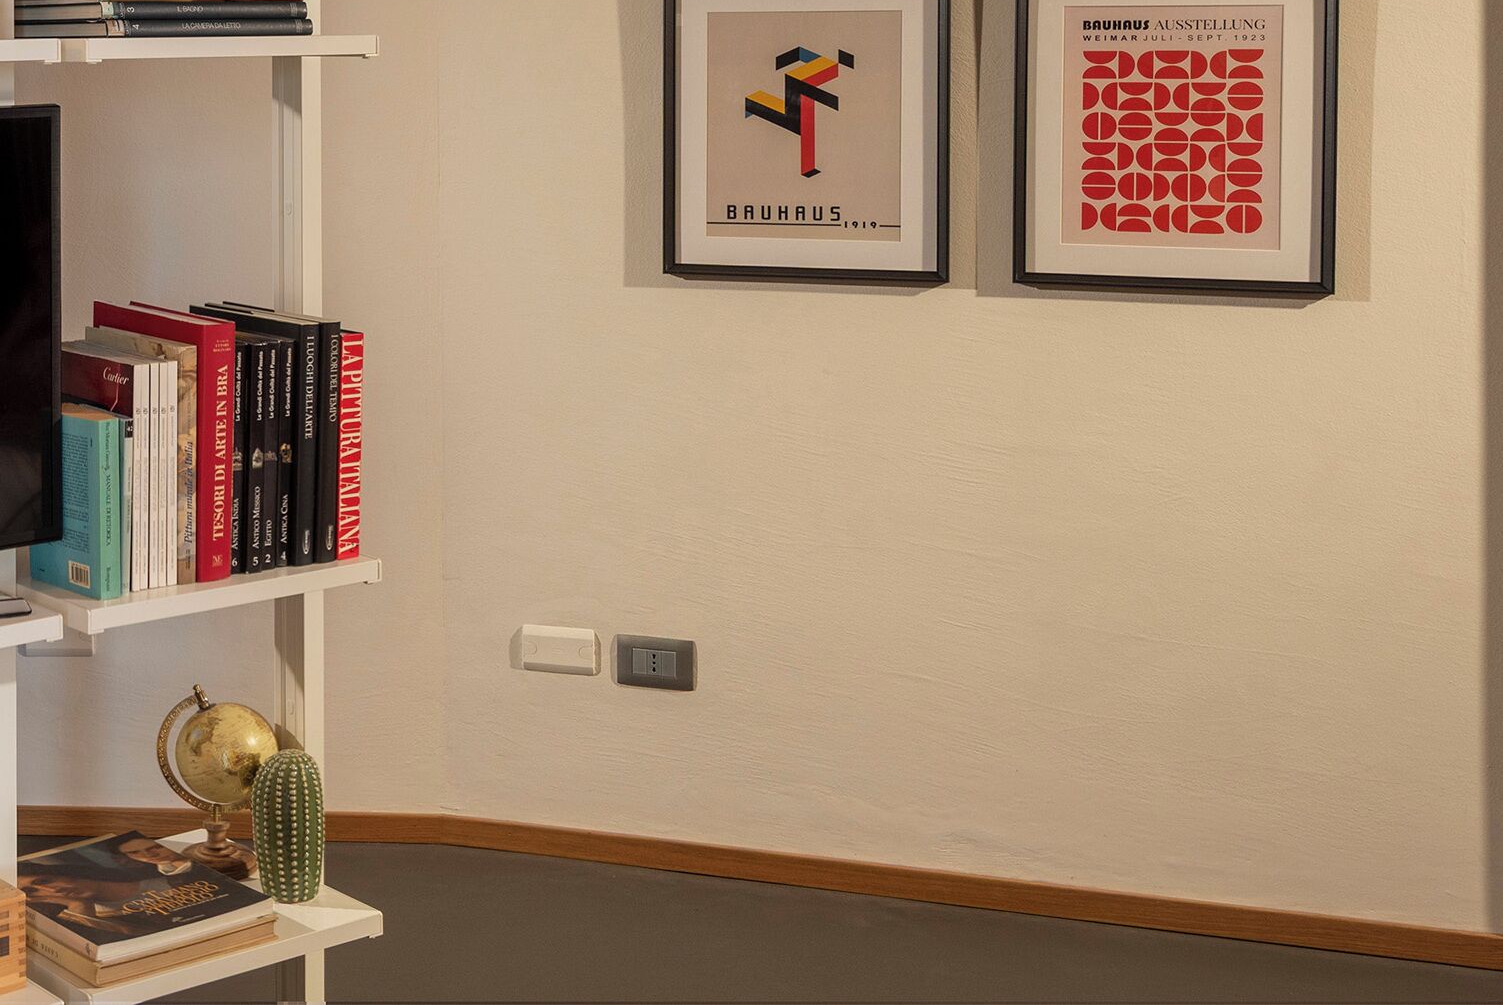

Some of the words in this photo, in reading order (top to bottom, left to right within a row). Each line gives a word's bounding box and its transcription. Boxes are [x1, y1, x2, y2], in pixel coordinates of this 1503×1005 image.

[1082, 19, 1150, 31] BAUHAUS
[1154, 18, 1266, 31] AUSSTELLUNG
[726, 205, 841, 222] BAUHAUS
[844, 221, 878, 229] 1919
[306, 342, 314, 383] LUOGHI
[330, 339, 338, 372] COLORI
[341, 340, 363, 364] LA
[102, 366, 130, 386] Cartier
[216, 365, 228, 396] BRA
[330, 374, 338, 390] DEL
[216, 400, 227, 416] IN
[304, 385, 314, 439] DELL'ARTE
[329, 392, 337, 422] TEMPO
[339, 368, 363, 459] PITTURA
[215, 420, 227, 459] ARTE
[184, 442, 193, 468] Italia
[214, 463, 225, 481] DI
[184, 479, 193, 510] murale
[280, 494, 288, 514] CINA
[338, 460, 362, 554] ITALIANA
[213, 485, 225, 541] TESORI
[184, 511, 193, 544] Pittura
[280, 515, 288, 544] ANTICA
[232, 558, 238, 567] 6
[252, 557, 259, 566] 5
[265, 554, 271, 563] 2
[281, 551, 287, 561] 4
